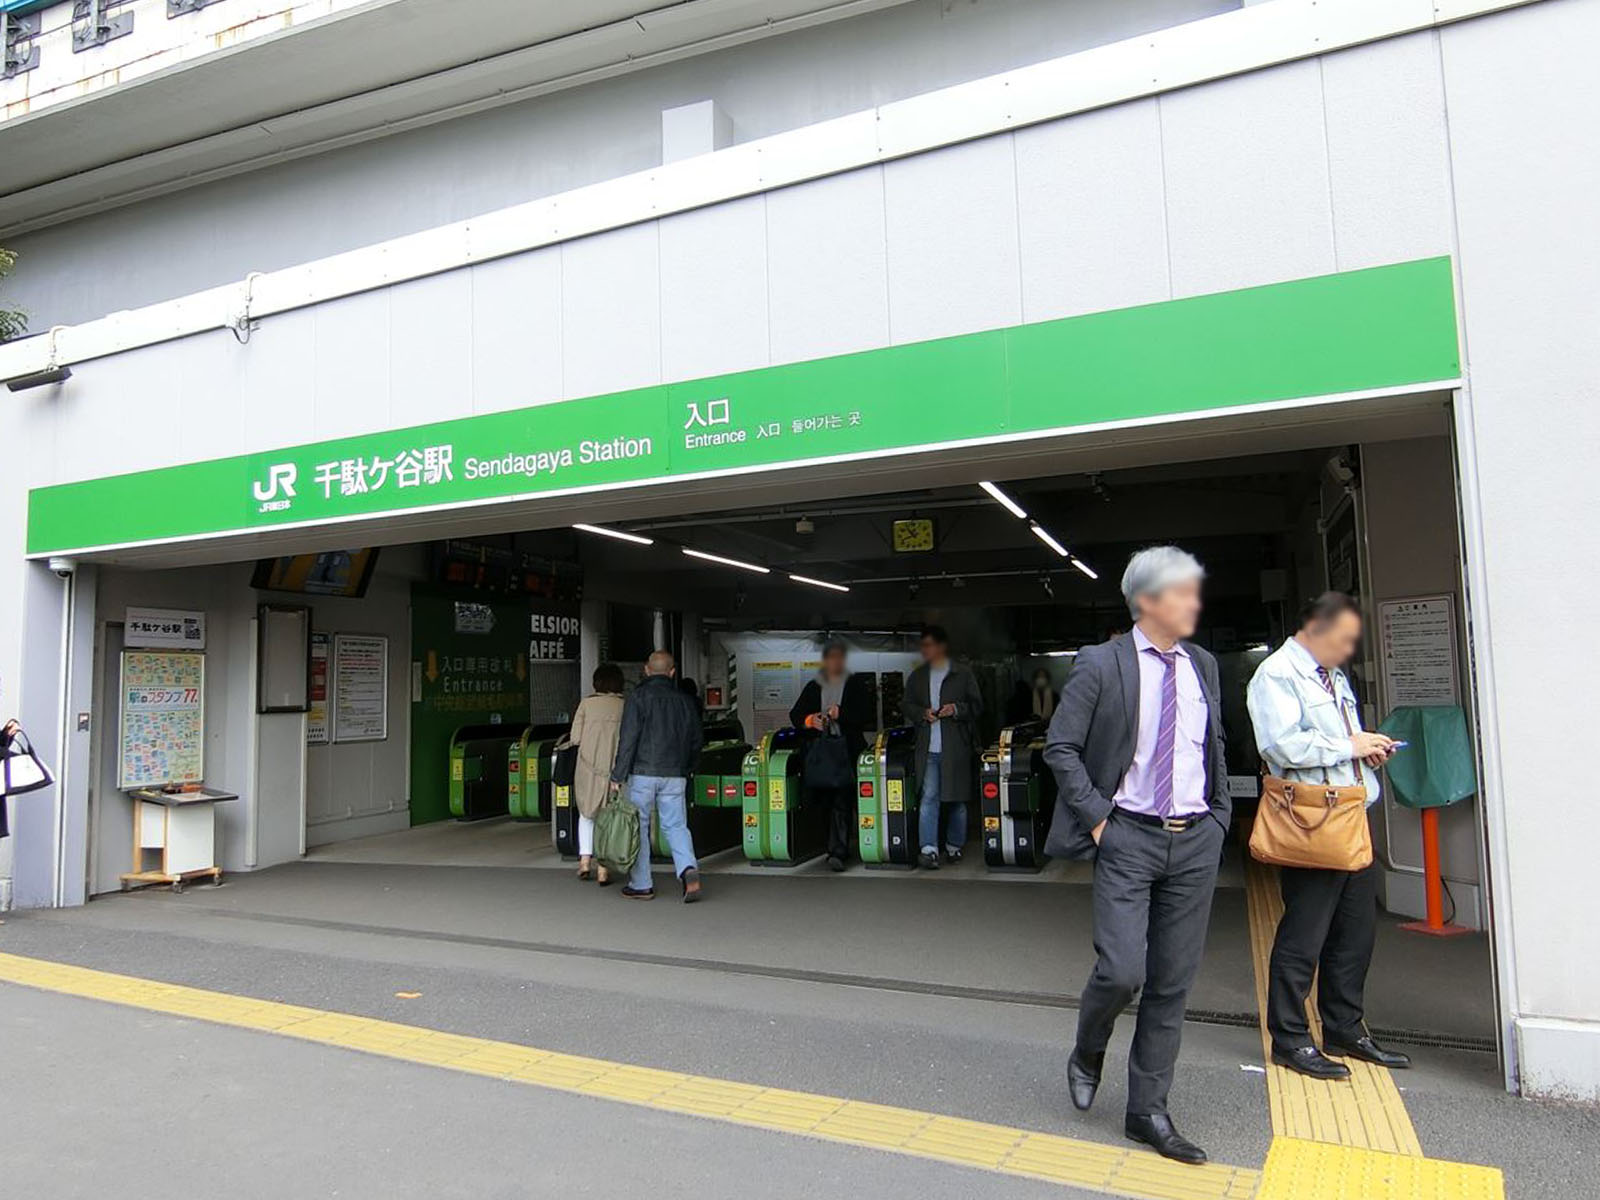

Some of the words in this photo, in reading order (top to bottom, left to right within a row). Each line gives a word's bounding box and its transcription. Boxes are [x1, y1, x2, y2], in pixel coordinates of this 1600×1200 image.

[684, 399, 730, 430] 入口
[791, 415, 843, 433] 들어가는
[848, 411, 862, 426] 곳
[685, 430, 746, 449] Entrance
[756, 423, 781, 439] 入口
[465, 449, 573, 480] Sendagaya
[579, 436, 652, 464] Station
[253, 463, 298, 501] JR
[530, 614, 580, 636] ELSIOR
[529, 637, 565, 660] AFFÉ
[443, 676, 503, 693] Entrance
[859, 754, 875, 765] IC
